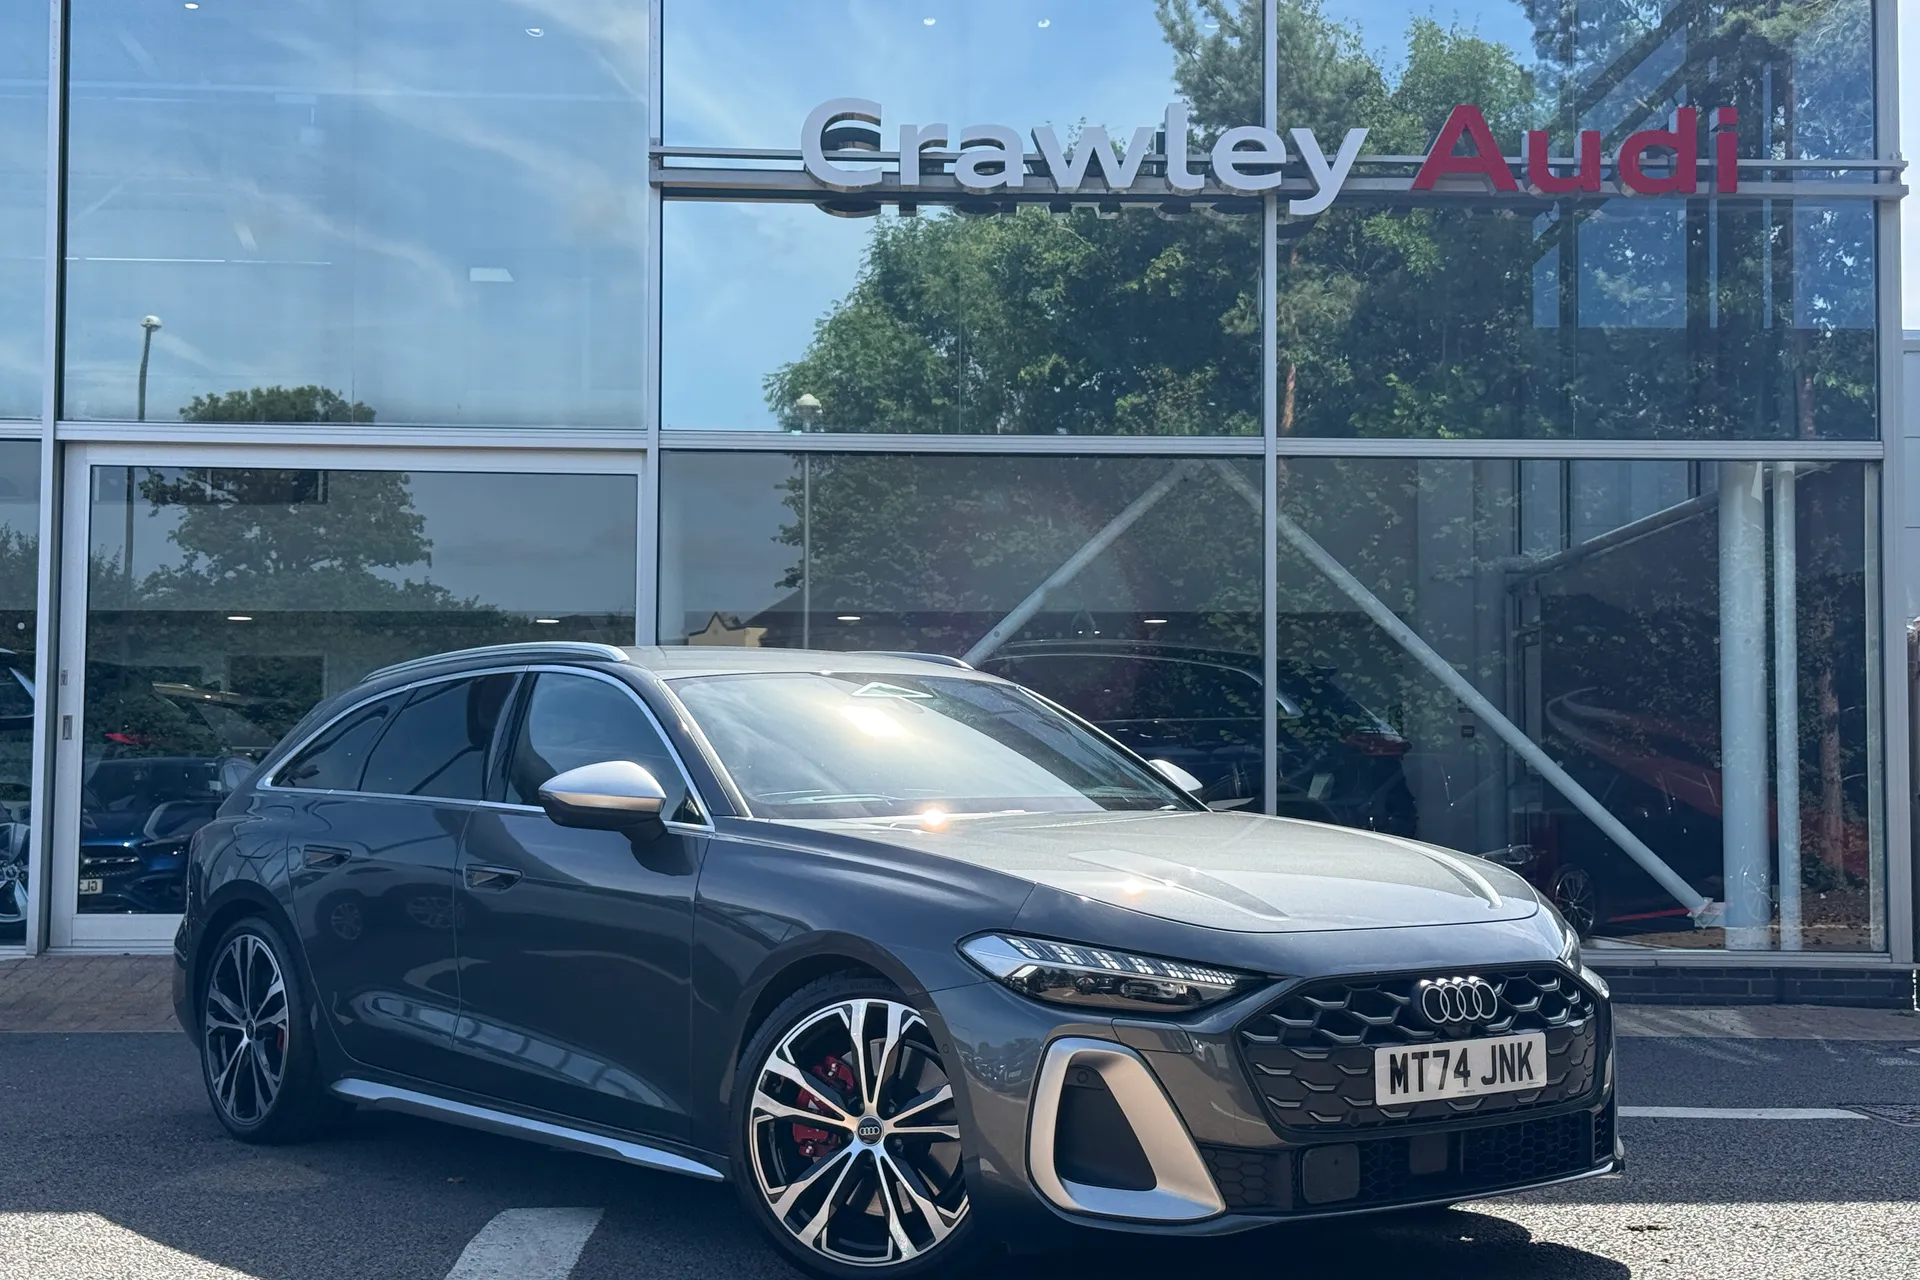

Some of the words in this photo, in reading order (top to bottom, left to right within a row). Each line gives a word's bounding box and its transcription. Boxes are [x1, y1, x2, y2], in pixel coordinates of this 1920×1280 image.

[800, 97, 1368, 216] Crawley
[1411, 104, 1739, 195] Audi
[1389, 1048, 1471, 1095] MT74
[1480, 1041, 1534, 1086] JNK
